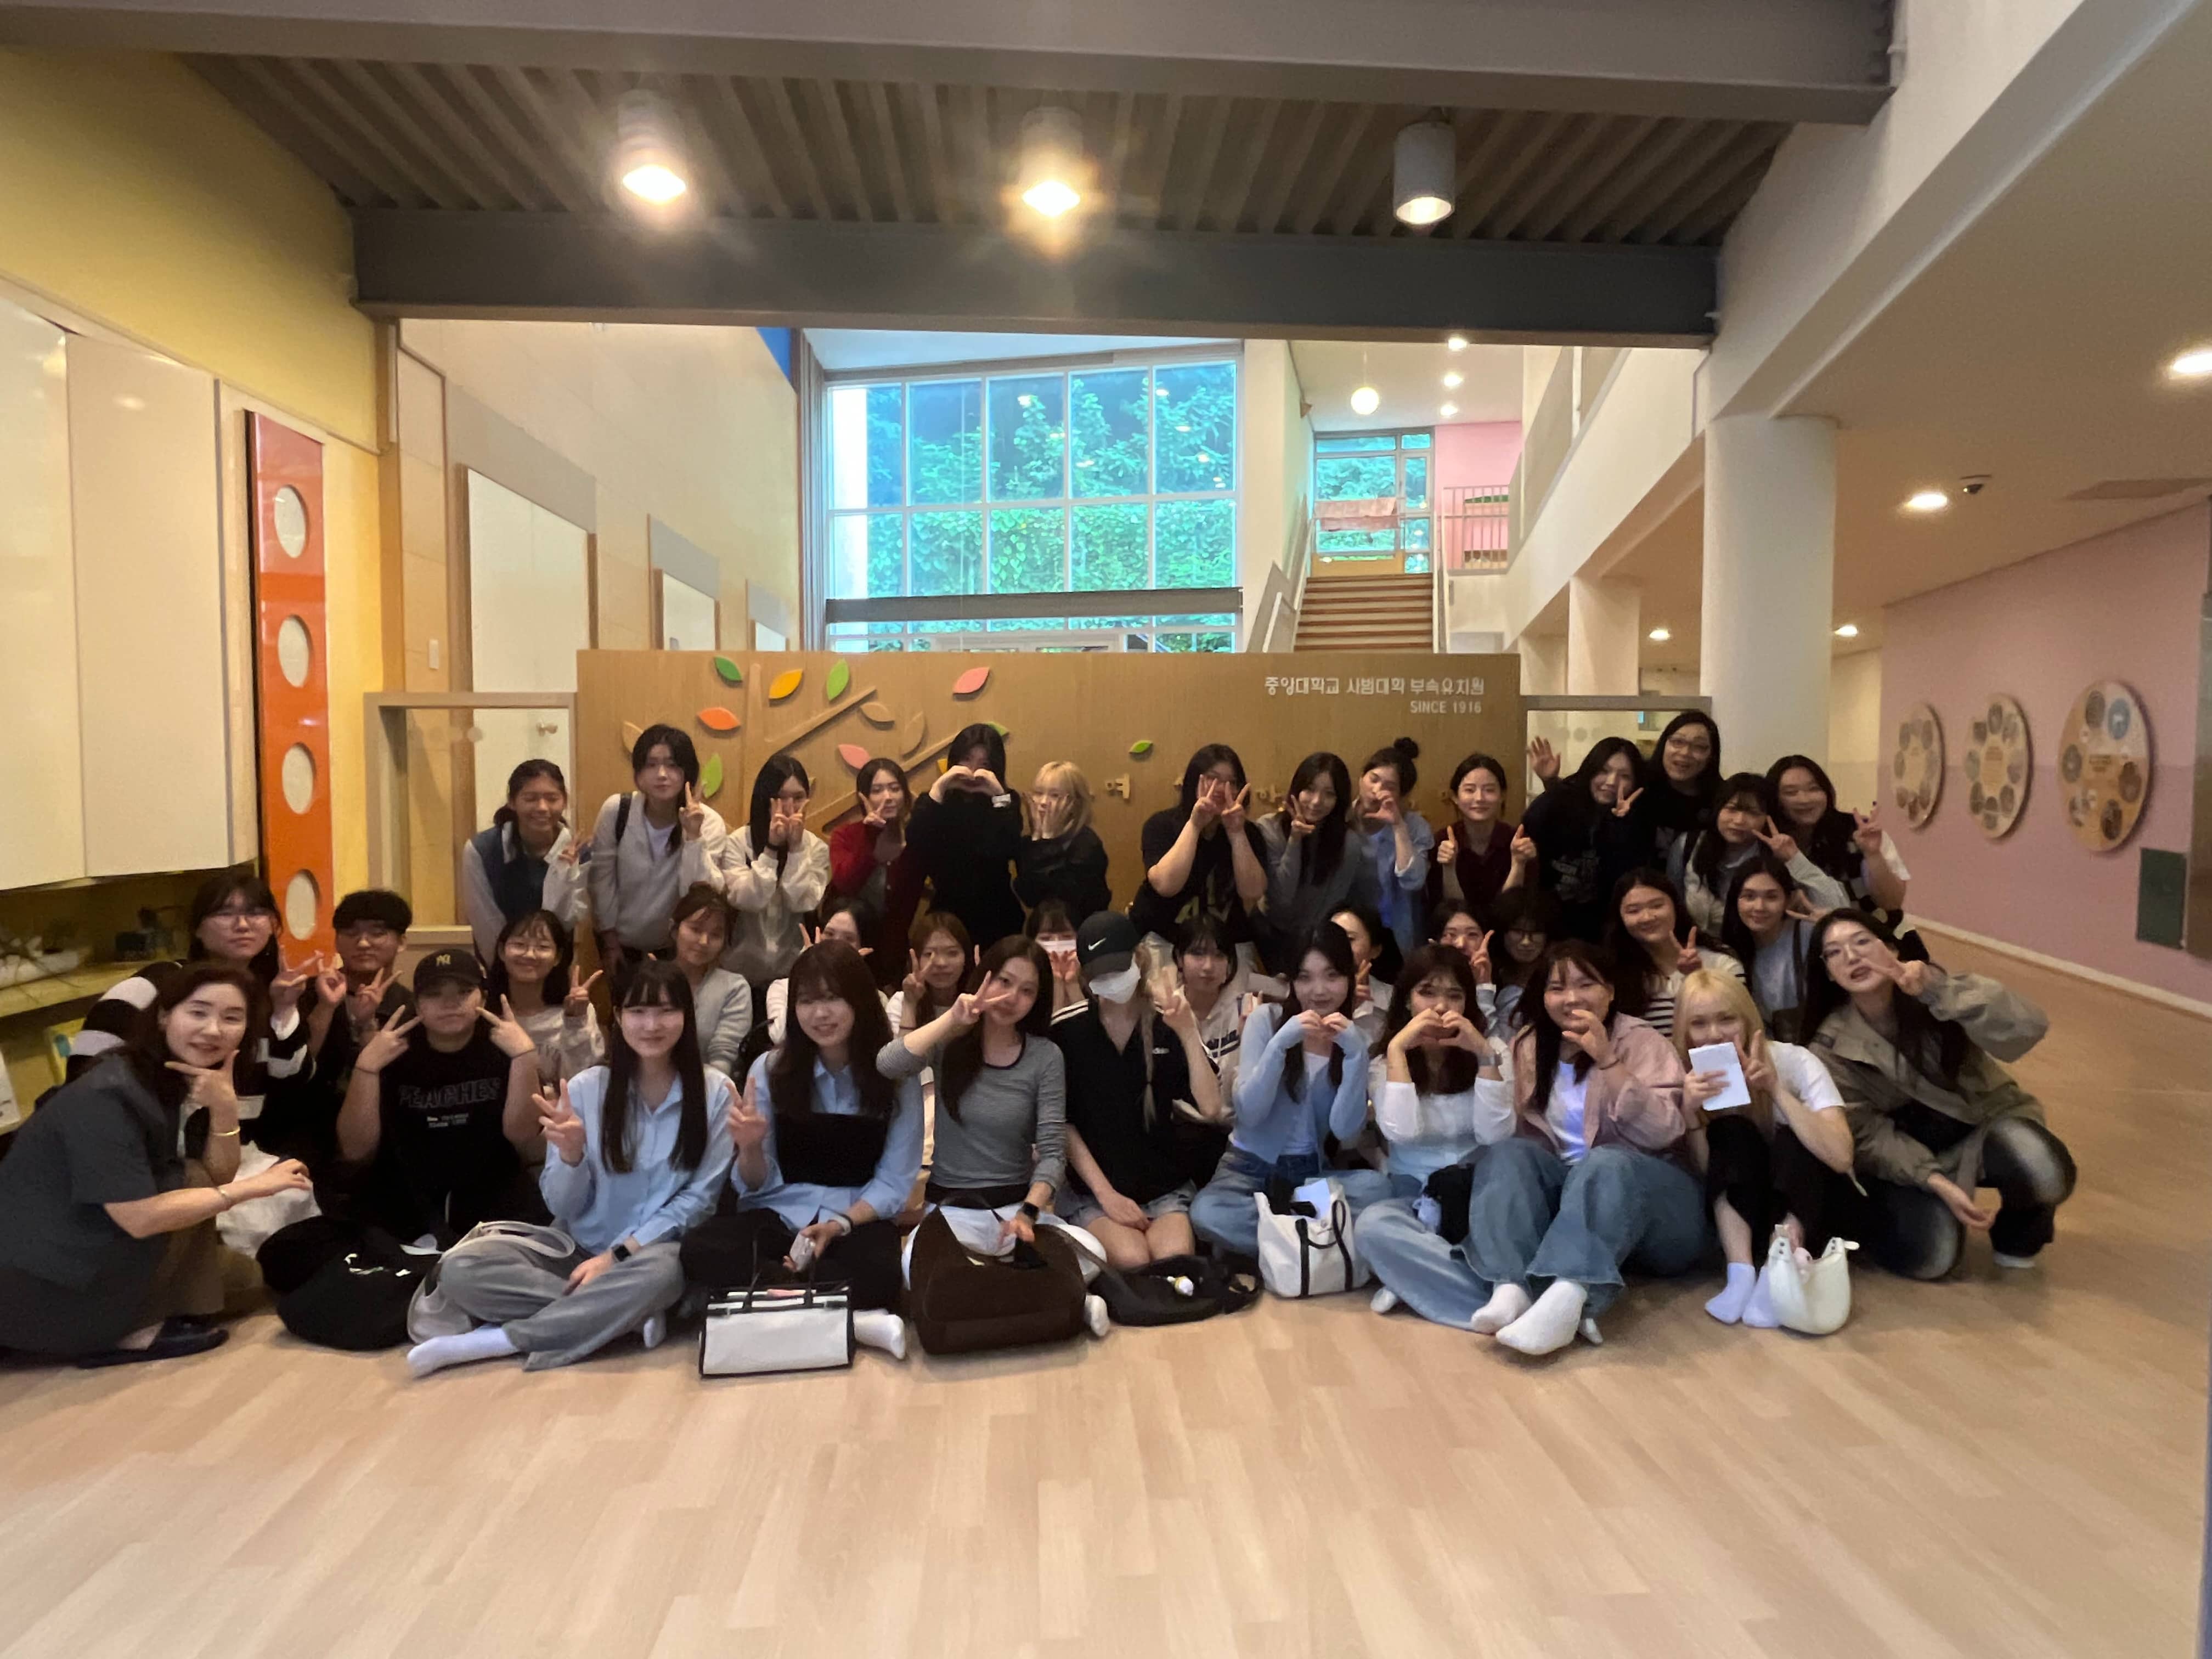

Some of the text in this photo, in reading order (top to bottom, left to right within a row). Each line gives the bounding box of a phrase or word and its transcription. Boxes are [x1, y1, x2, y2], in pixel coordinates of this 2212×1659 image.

[1265, 676, 1485, 696] 중앙대학교 사범대학 부속유치원
[1410, 701, 1481, 713] SINCE 1916
